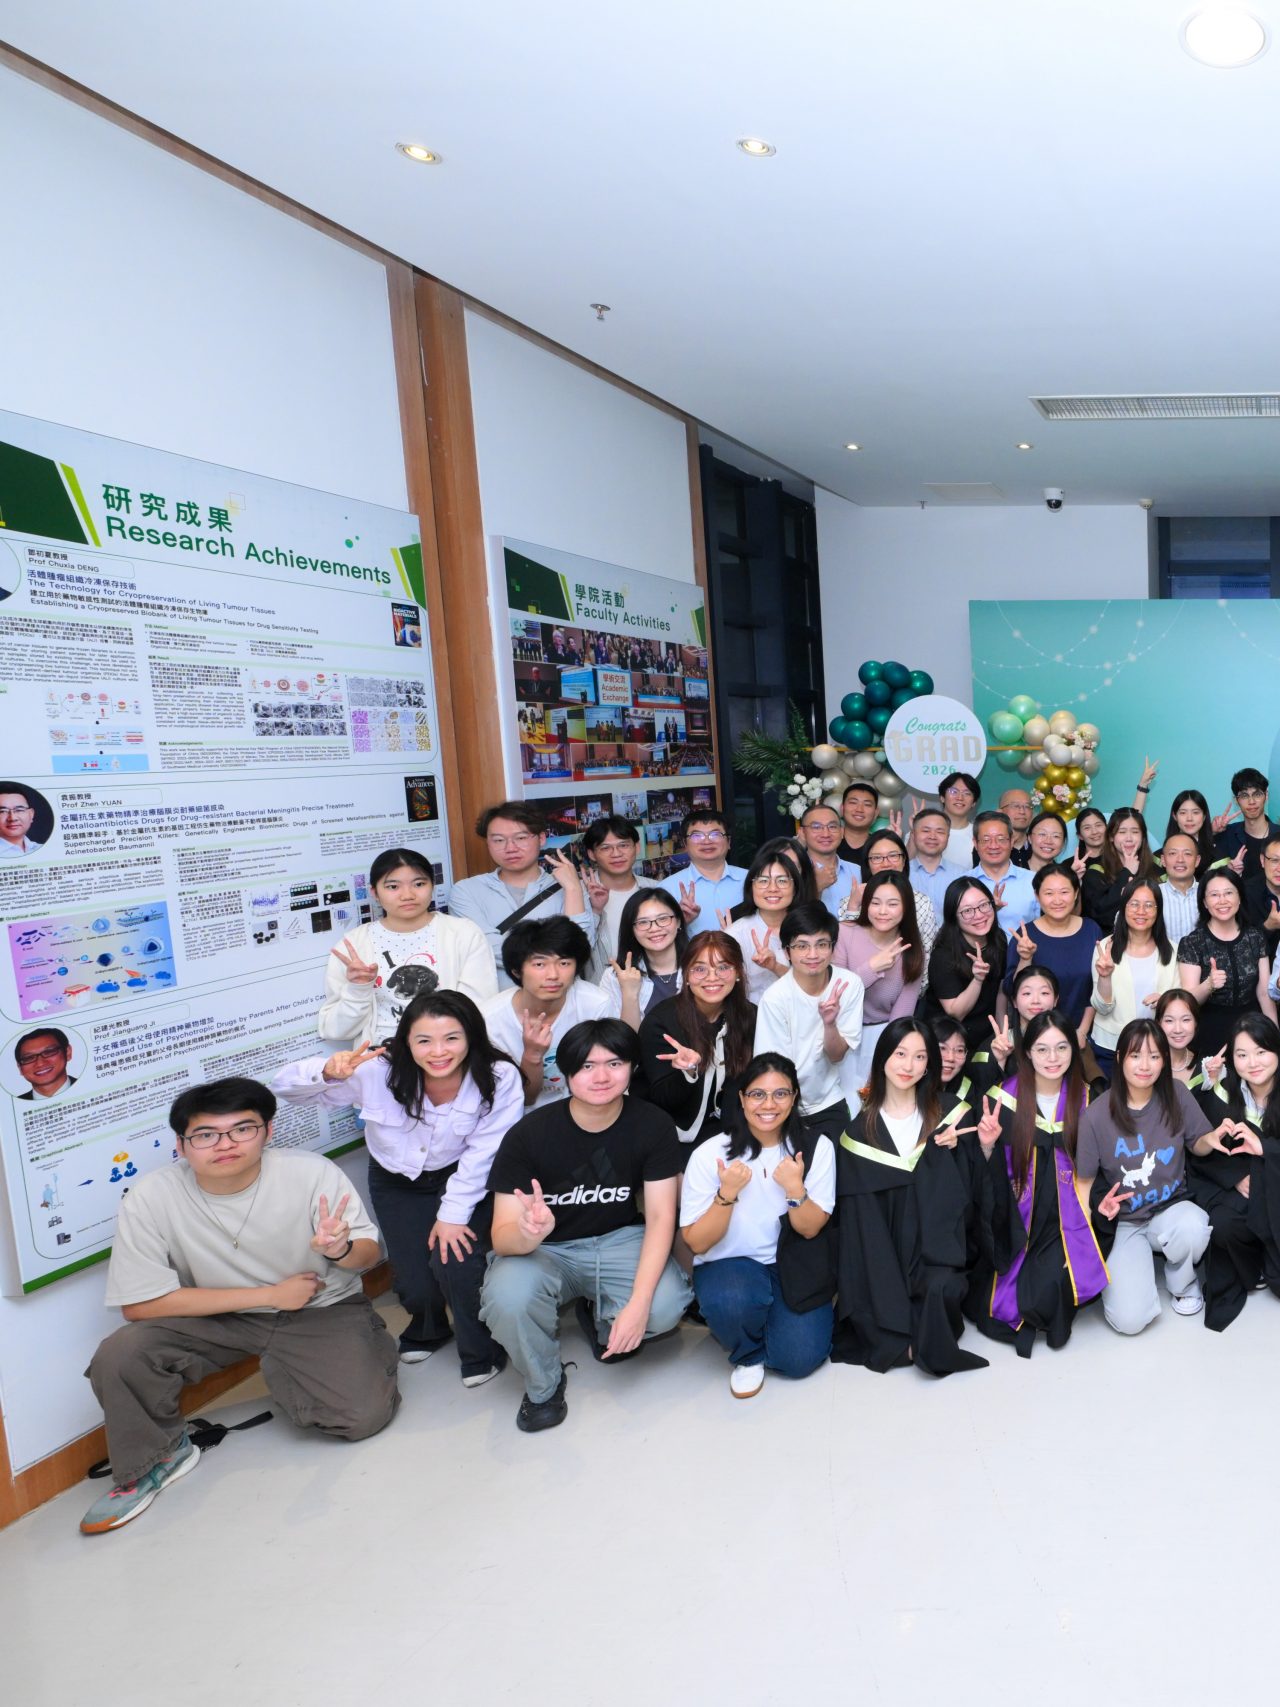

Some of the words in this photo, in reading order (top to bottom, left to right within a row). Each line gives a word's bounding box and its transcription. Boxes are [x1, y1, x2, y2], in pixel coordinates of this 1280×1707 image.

[102, 484, 233, 533] 研究成果
[106, 516, 235, 557] Research
[245, 542, 391, 585] Achievements
[48, 560, 74, 569] Chuxia
[77, 564, 99, 572] DENG
[27, 578, 45, 587] The
[49, 581, 100, 595] Technology
[118, 590, 186, 604] Cryopreservation
[198, 600, 220, 609] Living
[222, 602, 248, 611] Tumour
[250, 606, 275, 615] Tissues
[575, 584, 624, 608] 學院活動
[30, 597, 78, 609] Establishing
[87, 604, 138, 615] Cryopreserved
[140, 609, 167, 617] Biobank
[178, 614, 197, 622] Living
[223, 618, 245, 626] Tissues
[576, 603, 618, 625] Faculty
[623, 612, 670, 631] Activities
[602, 684, 628, 692] Academic
[603, 694, 628, 703] Exchange
[905, 717, 967, 735] Congrats
[895, 735, 983, 762] GRAD
[923, 765, 956, 776] 2026
[407, 780, 434, 788] Advances
[60, 818, 138, 830] Metalloantibiotics
[140, 816, 164, 825] Drugs
[180, 811, 234, 821] Drug-resistant
[235, 808, 265, 816] Bacterial
[267, 806, 300, 814] Meningitis
[63, 837, 115, 848] Supercharged
[120, 834, 152, 842] Precision
[184, 828, 219, 836] Genetically
[222, 825, 255, 833] Engineered
[64, 845, 116, 855] Acinetobacter
[118, 842, 154, 850] Baumannii
[93, 1046, 134, 1062] Increased
[136, 1040, 152, 1050] Use
[155, 1037, 163, 1045] of
[166, 1024, 214, 1042] Psychotropic
[216, 1017, 237, 1029] Drugs
[238, 1015, 246, 1023] by
[248, 1007, 274, 1019] Parents
[275, 1003, 290, 1012] After
[314, 993, 326, 1001] Can
[94, 1032, 109, 1040] Prof
[112, 1023, 147, 1037] Jianguang
[96, 1062, 136, 1079] Long-Term
[138, 1054, 162, 1066] Pattern
[173, 1040, 213, 1056] Psychotropic
[214, 1031, 247, 1044] Medication
[248, 1026, 262, 1034] Uses
[263, 1021, 282, 1031] among
[282, 1014, 304, 1024] Swedish
[304, 1009, 320, 1017] Paren
[542, 1184, 631, 1206] adidas
